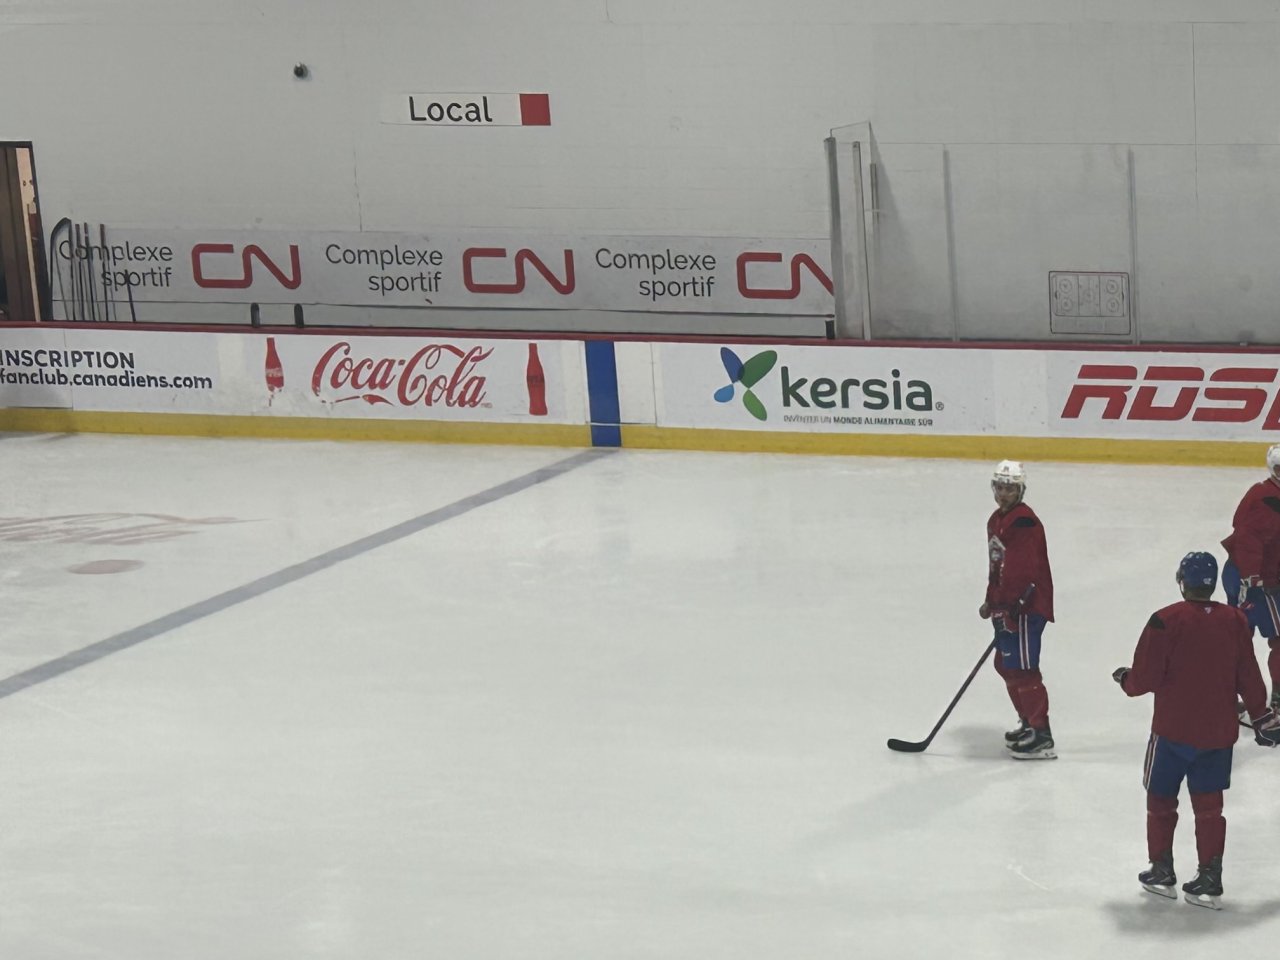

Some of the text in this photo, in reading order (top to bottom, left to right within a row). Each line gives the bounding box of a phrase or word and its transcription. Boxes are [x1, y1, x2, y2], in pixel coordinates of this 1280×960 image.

[409, 96, 493, 122] Local
[60, 240, 173, 266] Complexe
[325, 244, 443, 270] Complexe
[595, 248, 716, 275] Complexe
[101, 267, 173, 291] sportif
[191, 243, 302, 290] CN
[462, 247, 576, 295] CN
[736, 252, 835, 300] CN
[368, 271, 442, 296] sportif
[639, 276, 716, 301] sportif
[0, 349, 135, 369] INSCRIPTION
[0, 367, 213, 389] fanclub.canadiens.com
[311, 341, 495, 409] Coca-Cola
[781, 366, 933, 412] kersia
[833, 416, 862, 425] MONDE
